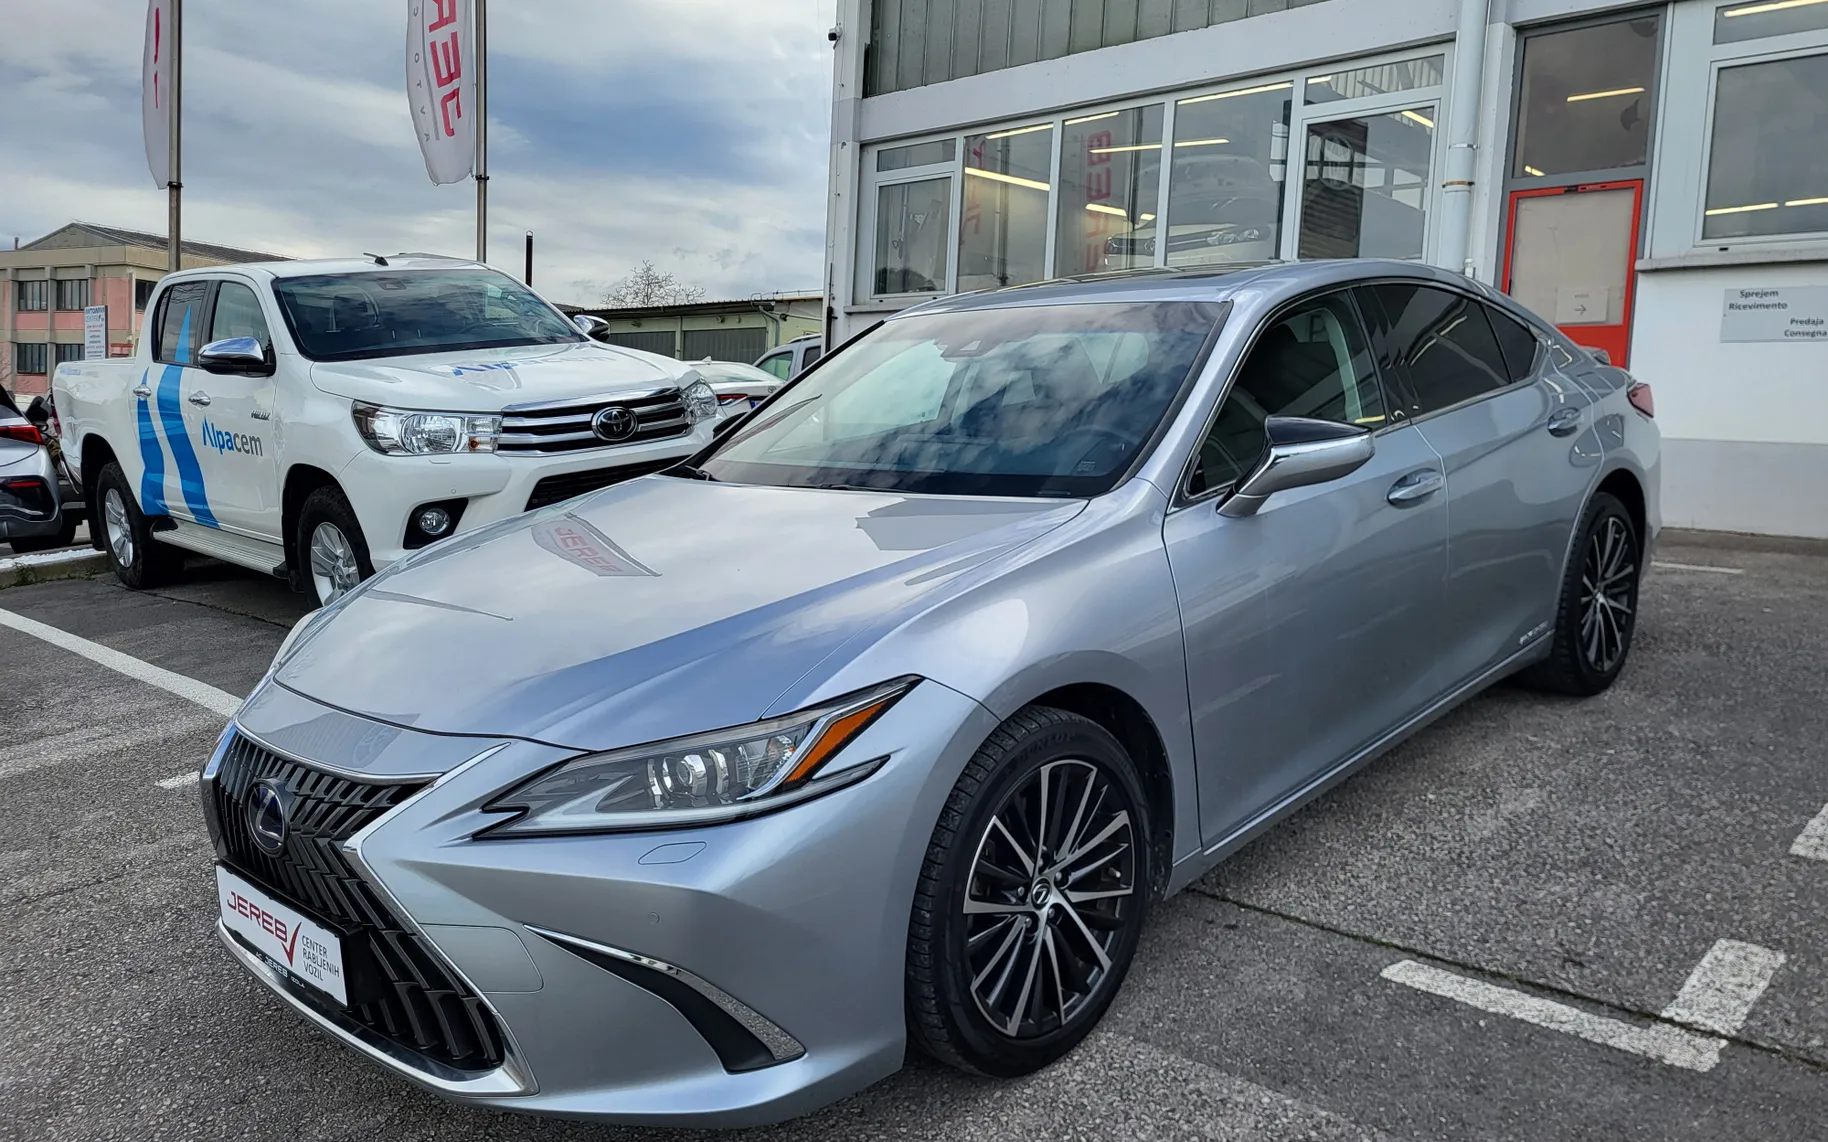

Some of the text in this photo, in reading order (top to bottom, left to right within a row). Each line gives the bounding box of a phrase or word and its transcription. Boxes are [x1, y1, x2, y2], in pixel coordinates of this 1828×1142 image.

[1740, 289, 1779, 299] Sprejem
[1728, 302, 1788, 311] Ricevimento
[1790, 317, 1824, 326] Predaja
[1784, 328, 1828, 338] Consegna
[202, 415, 263, 457] Alpacem
[226, 890, 288, 943] JEREB
[301, 935, 328, 959] CENTER
[264, 956, 288, 978] JEREB
[302, 948, 340, 978] RABLJENIH
[303, 961, 324, 981] VOZIL
